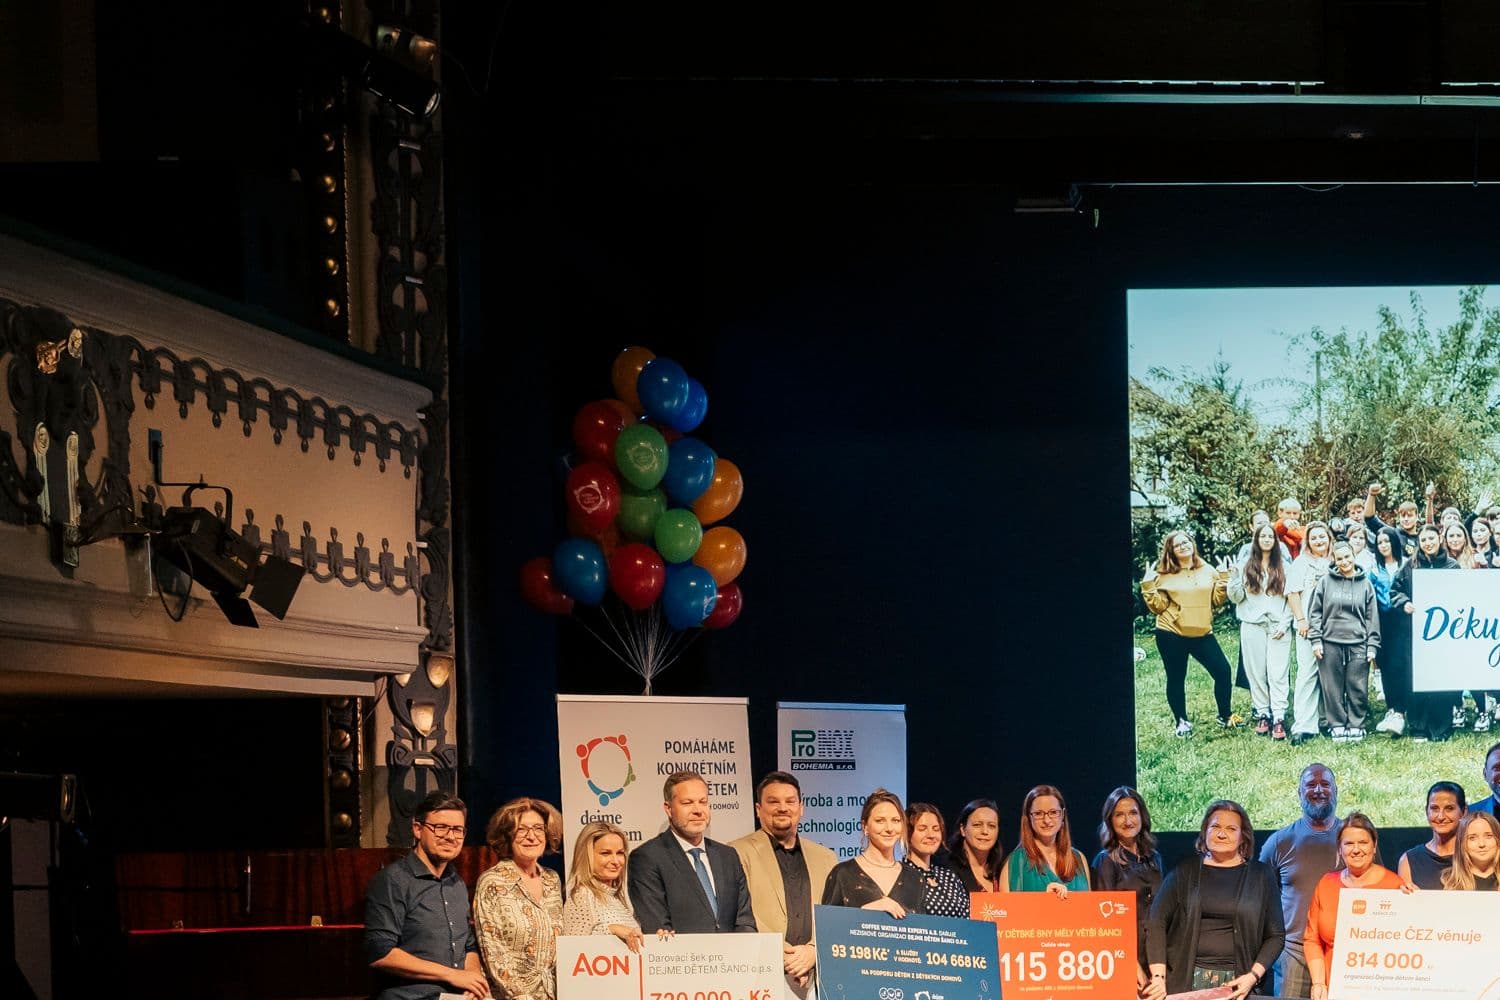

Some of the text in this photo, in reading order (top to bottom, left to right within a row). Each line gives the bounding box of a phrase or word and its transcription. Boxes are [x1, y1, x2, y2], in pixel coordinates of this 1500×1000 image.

[664, 738, 735, 754] POMÁHÁME
[657, 760, 736, 775] KONKRÉTNÍM
[792, 762, 834, 770] BOHEMIA
[708, 780, 738, 796] ĚTEM
[1005, 928, 1035, 938] DĚTSKÉ
[1037, 928, 1051, 937] SNY
[1054, 927, 1073, 937] MĚLY
[1077, 927, 1097, 937] VĚTŠÍ
[1098, 927, 1122, 937] ŠANCI
[1349, 925, 1482, 944] Nadace ČEZ věnuje
[649, 952, 724, 963] Darovací šek pro
[832, 944, 847, 958] 93
[849, 945, 871, 960] 198
[572, 952, 630, 977] AON
[649, 962, 749, 975] DEJME DĚTEM ŠANCI
[926, 952, 987, 969] 104 668 Kč
[1000, 950, 1125, 982] 115 880 Kč
[1346, 952, 1423, 969] 814 000
